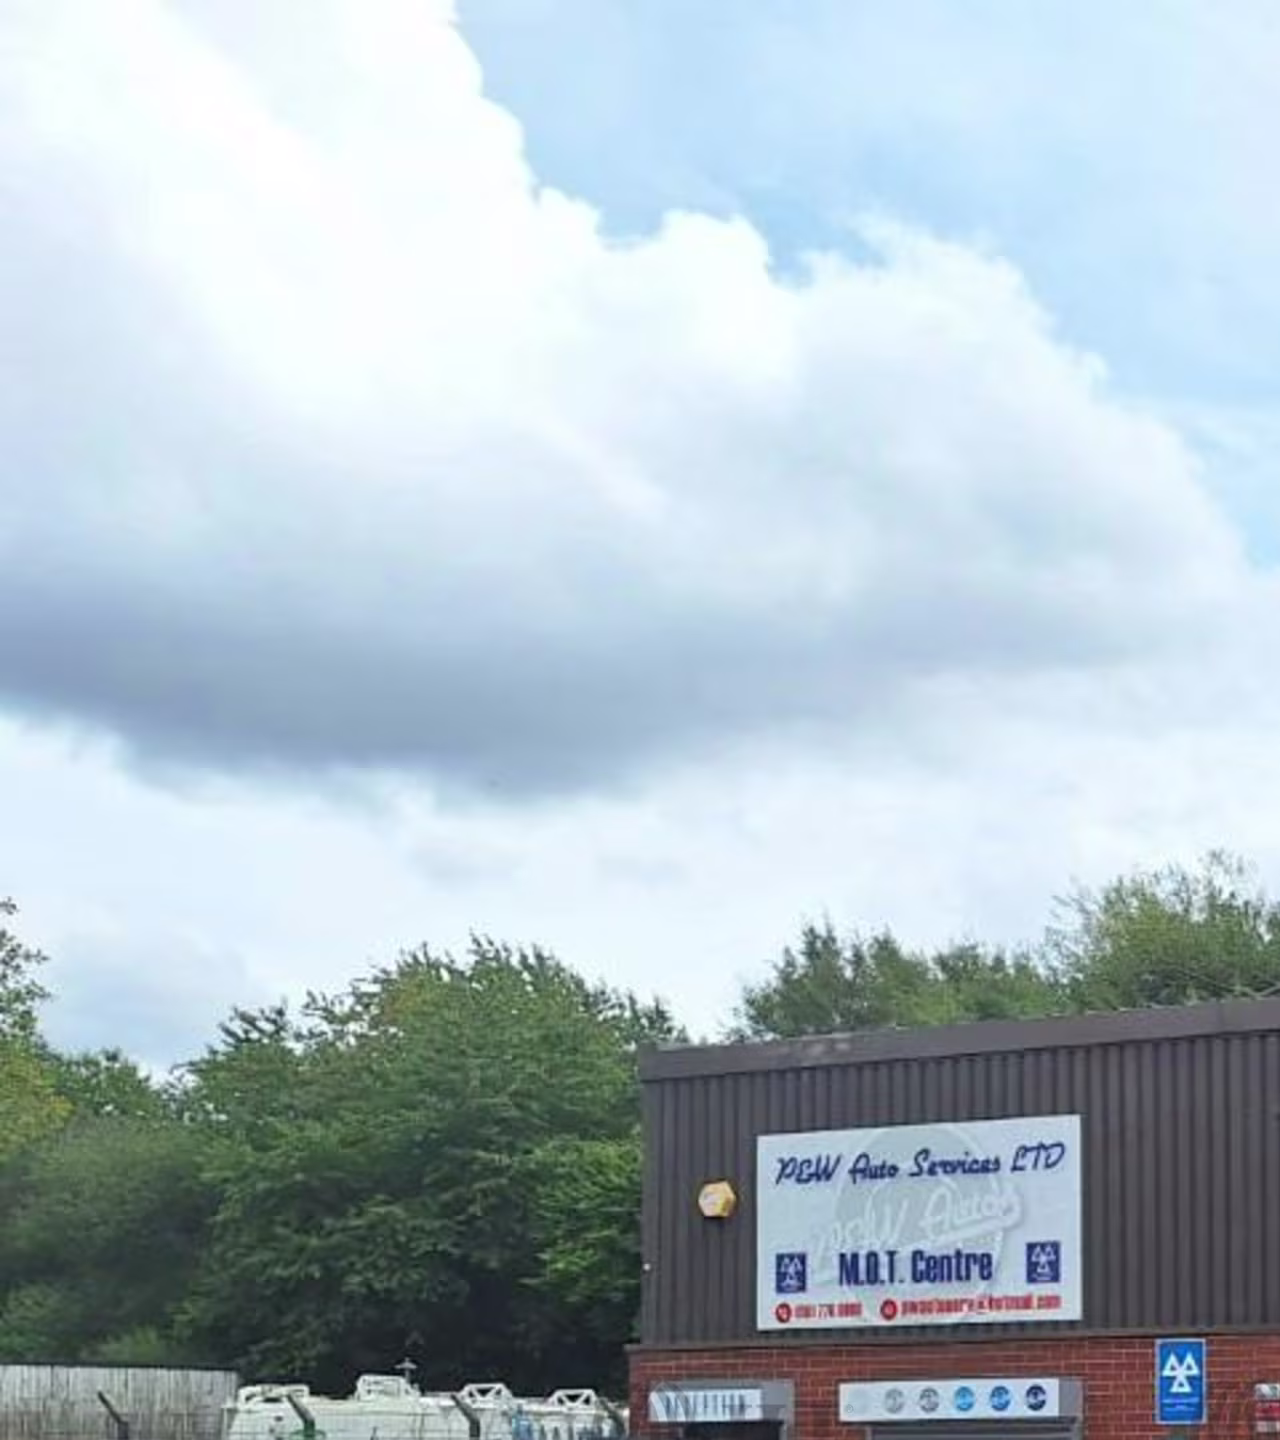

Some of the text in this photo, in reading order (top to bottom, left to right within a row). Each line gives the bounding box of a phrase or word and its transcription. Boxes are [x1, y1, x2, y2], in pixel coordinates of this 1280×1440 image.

[848, 1152, 899, 1184] Auto
[908, 1148, 1001, 1176] Services
[1010, 1141, 1066, 1173] LTD
[911, 1246, 993, 1284] Centre
